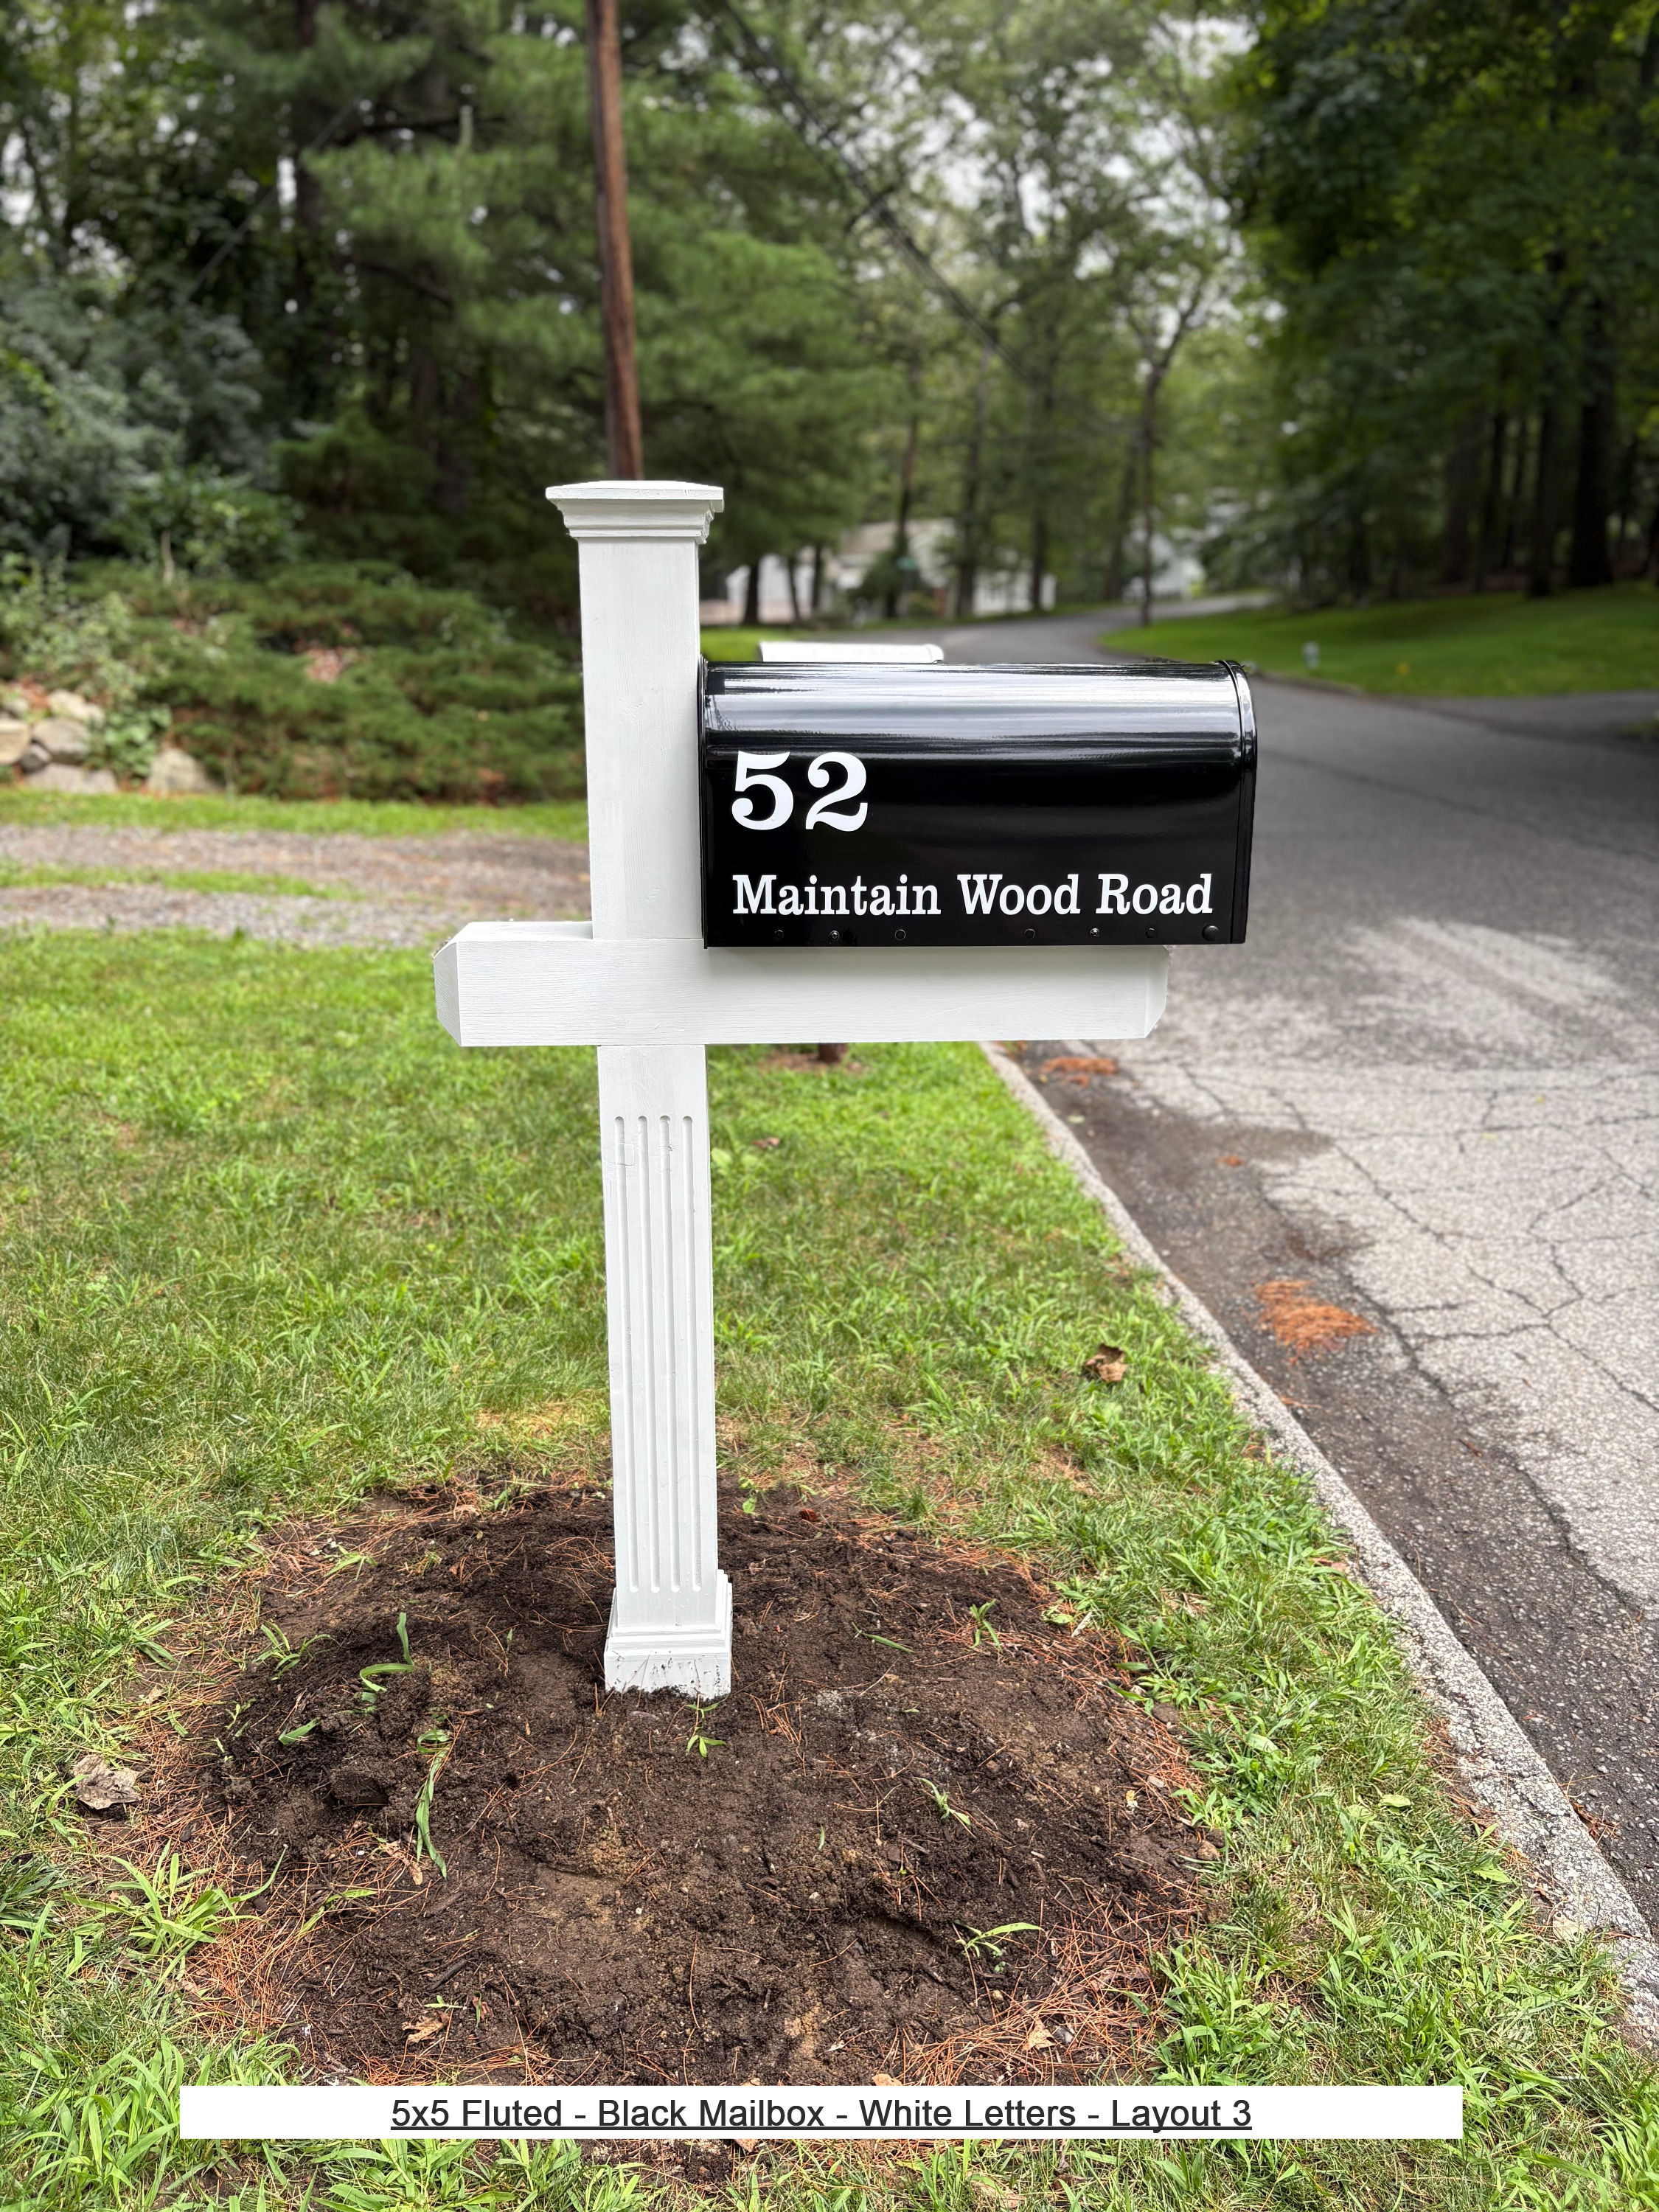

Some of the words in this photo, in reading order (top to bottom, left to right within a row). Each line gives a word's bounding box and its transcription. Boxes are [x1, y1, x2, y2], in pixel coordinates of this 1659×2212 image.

[732, 751, 868, 832] 52
[733, 874, 941, 916] Maintain
[957, 874, 1080, 916] Wood
[1096, 874, 1212, 915] Road
